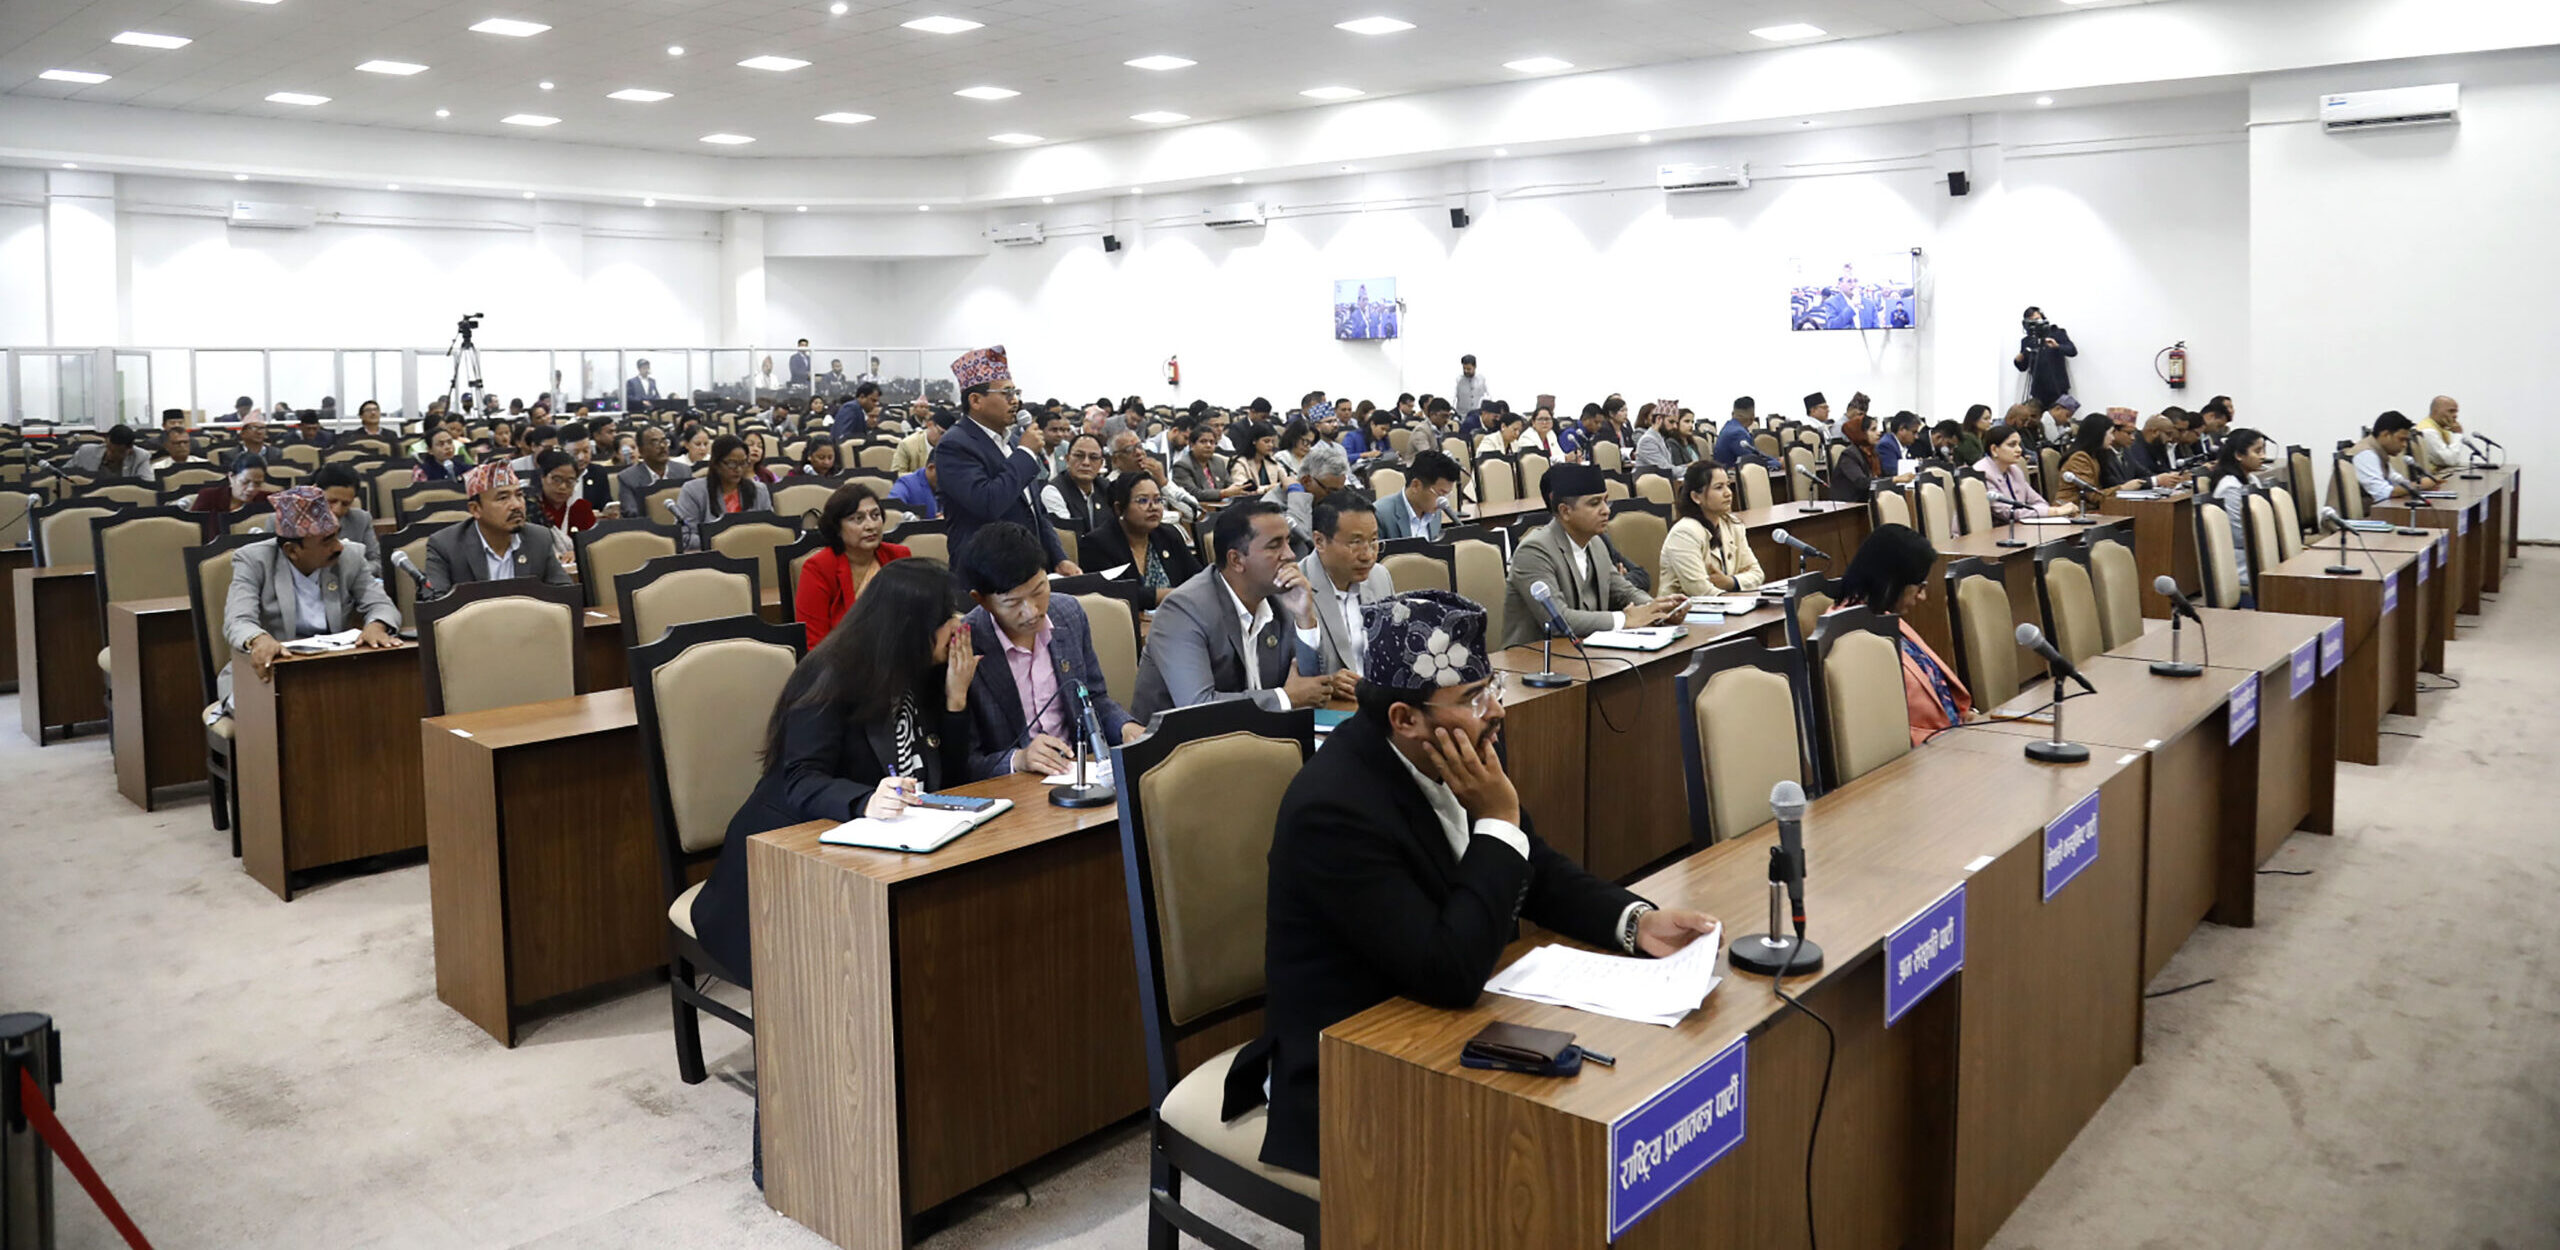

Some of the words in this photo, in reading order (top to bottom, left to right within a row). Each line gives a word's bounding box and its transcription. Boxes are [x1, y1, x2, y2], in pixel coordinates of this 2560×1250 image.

[1939, 916, 1954, 950] पार्टी
[1620, 1134, 1662, 1190] राष्ट्रिय
[1664, 1098, 1714, 1162] प्रजातन्त्र
[1715, 1072, 1740, 1118] पार्टी
